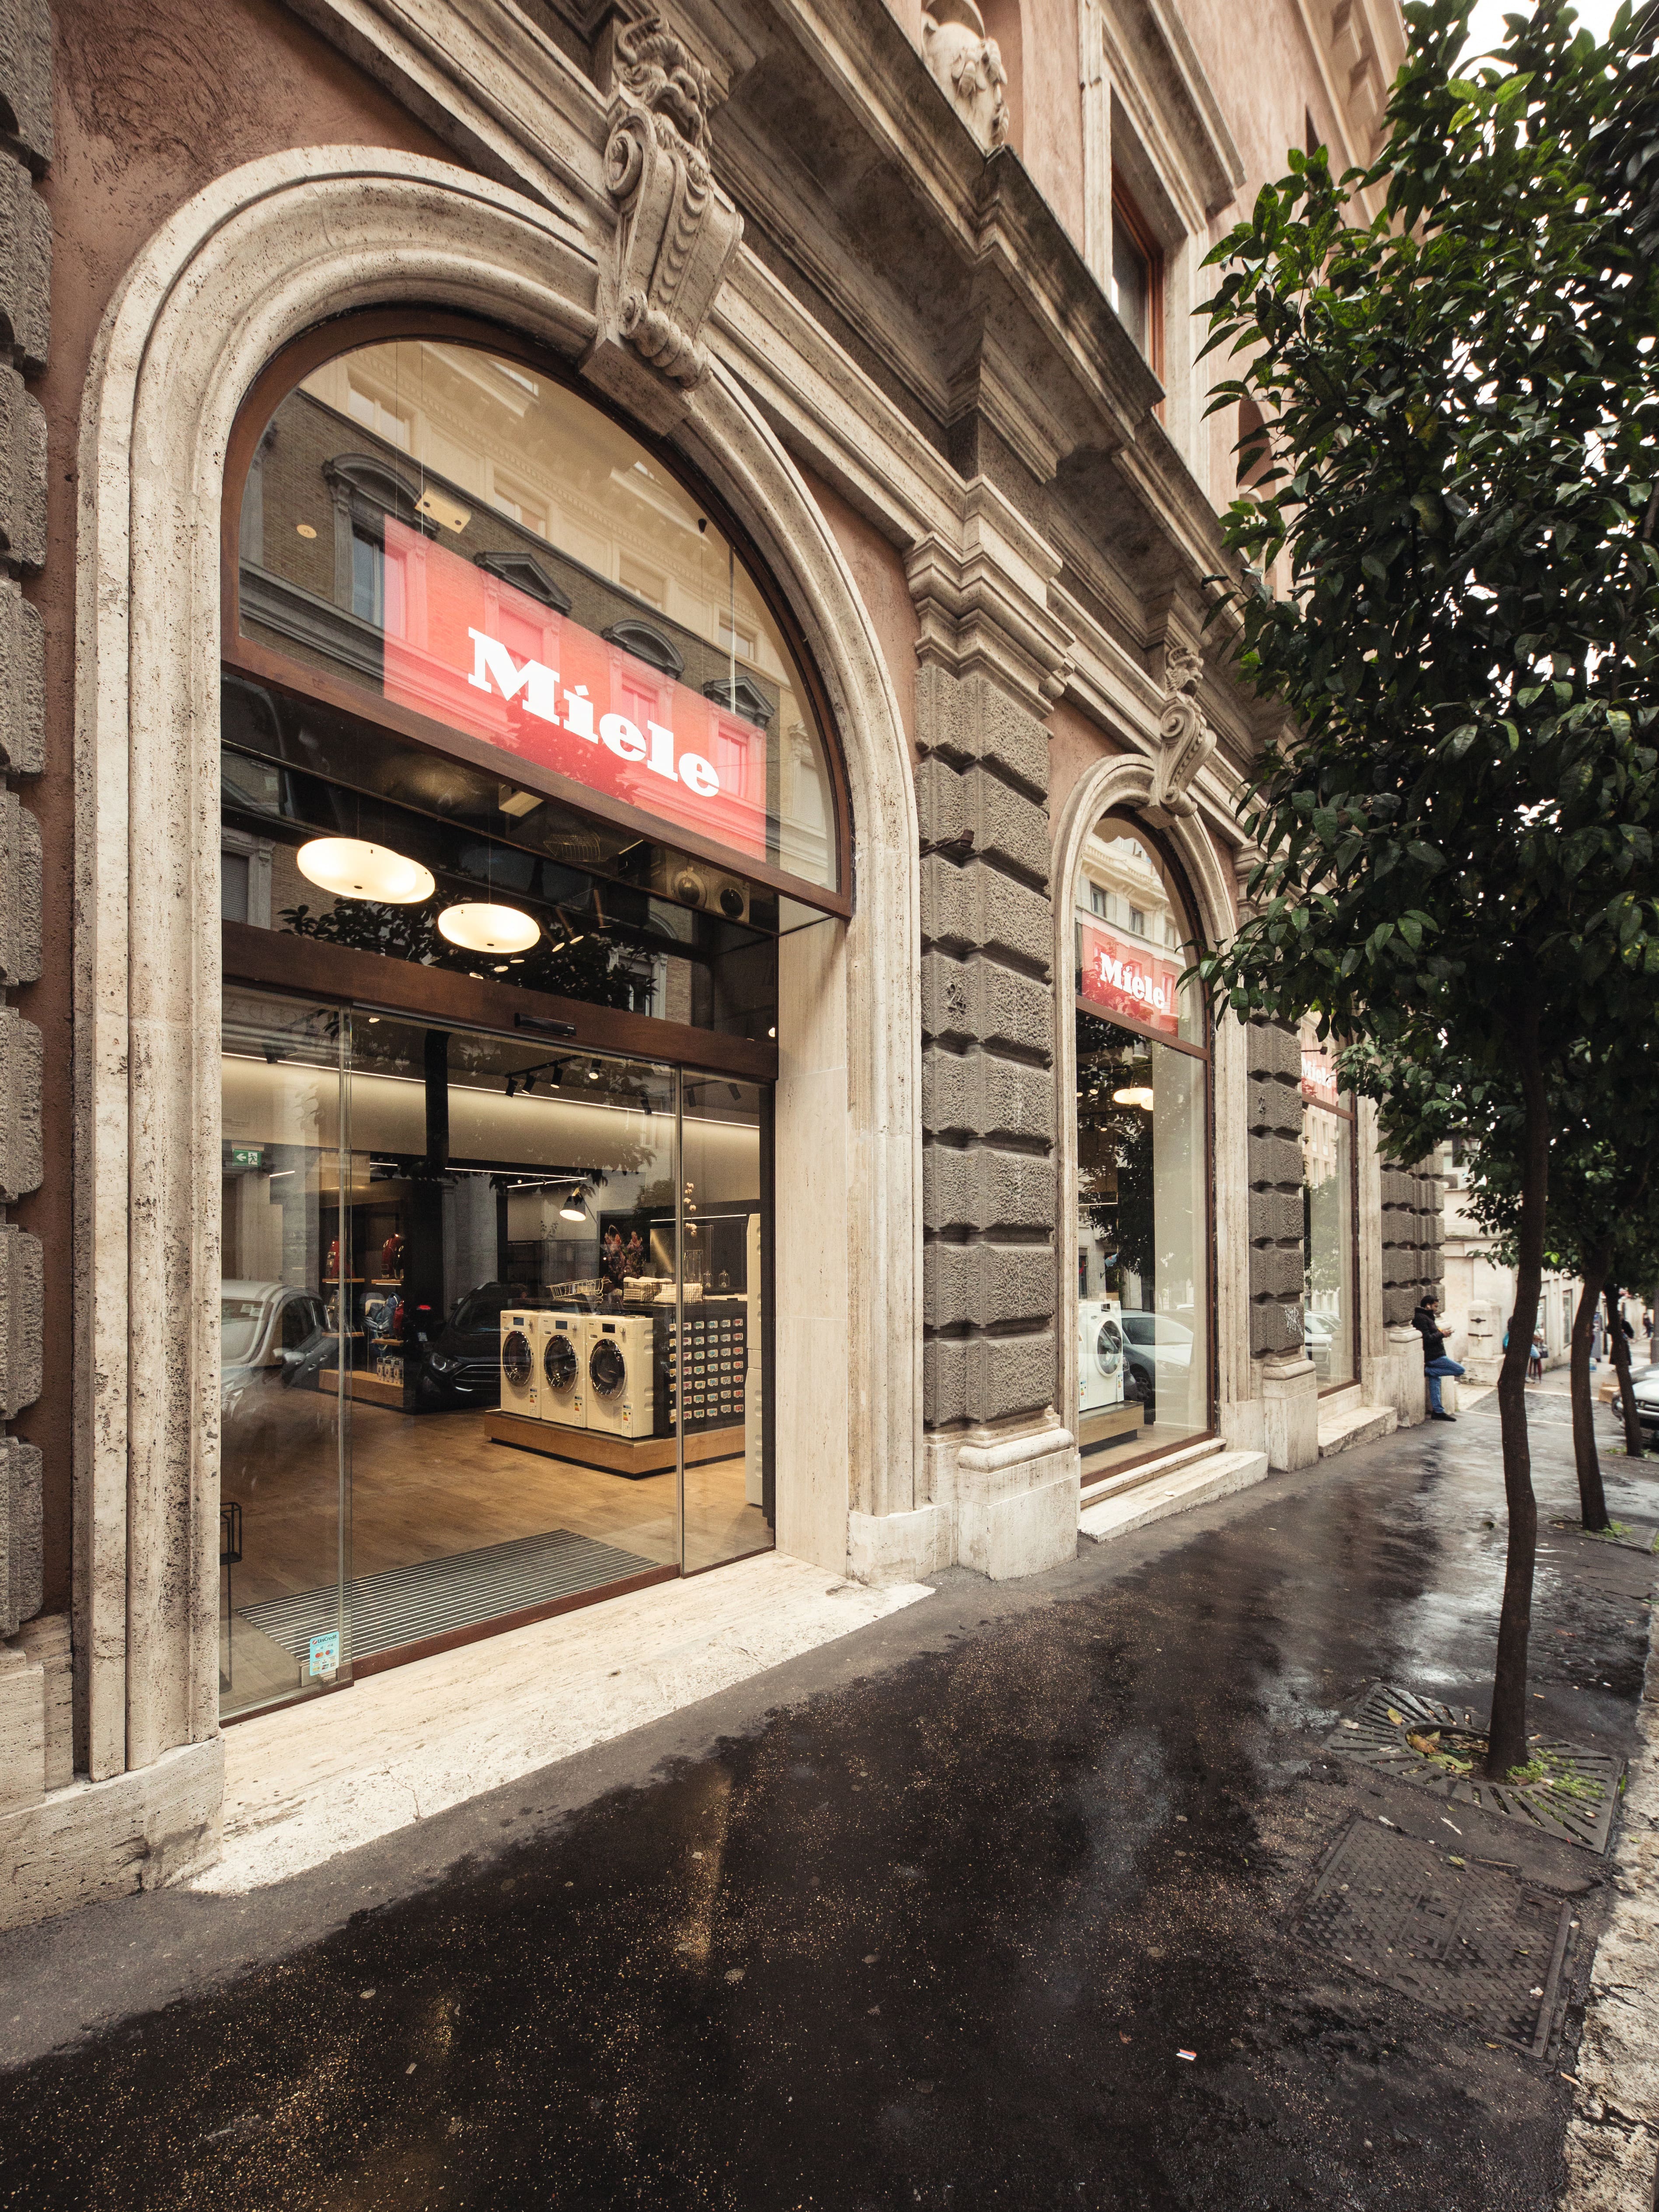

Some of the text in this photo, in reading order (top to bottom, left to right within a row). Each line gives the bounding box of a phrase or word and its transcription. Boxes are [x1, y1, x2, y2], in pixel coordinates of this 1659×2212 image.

[468, 627, 720, 797] Miele
[1100, 952, 1165, 1009] Miele
[1301, 1058, 1332, 1089] Miele
[318, 1634, 337, 1643] UniCredit
